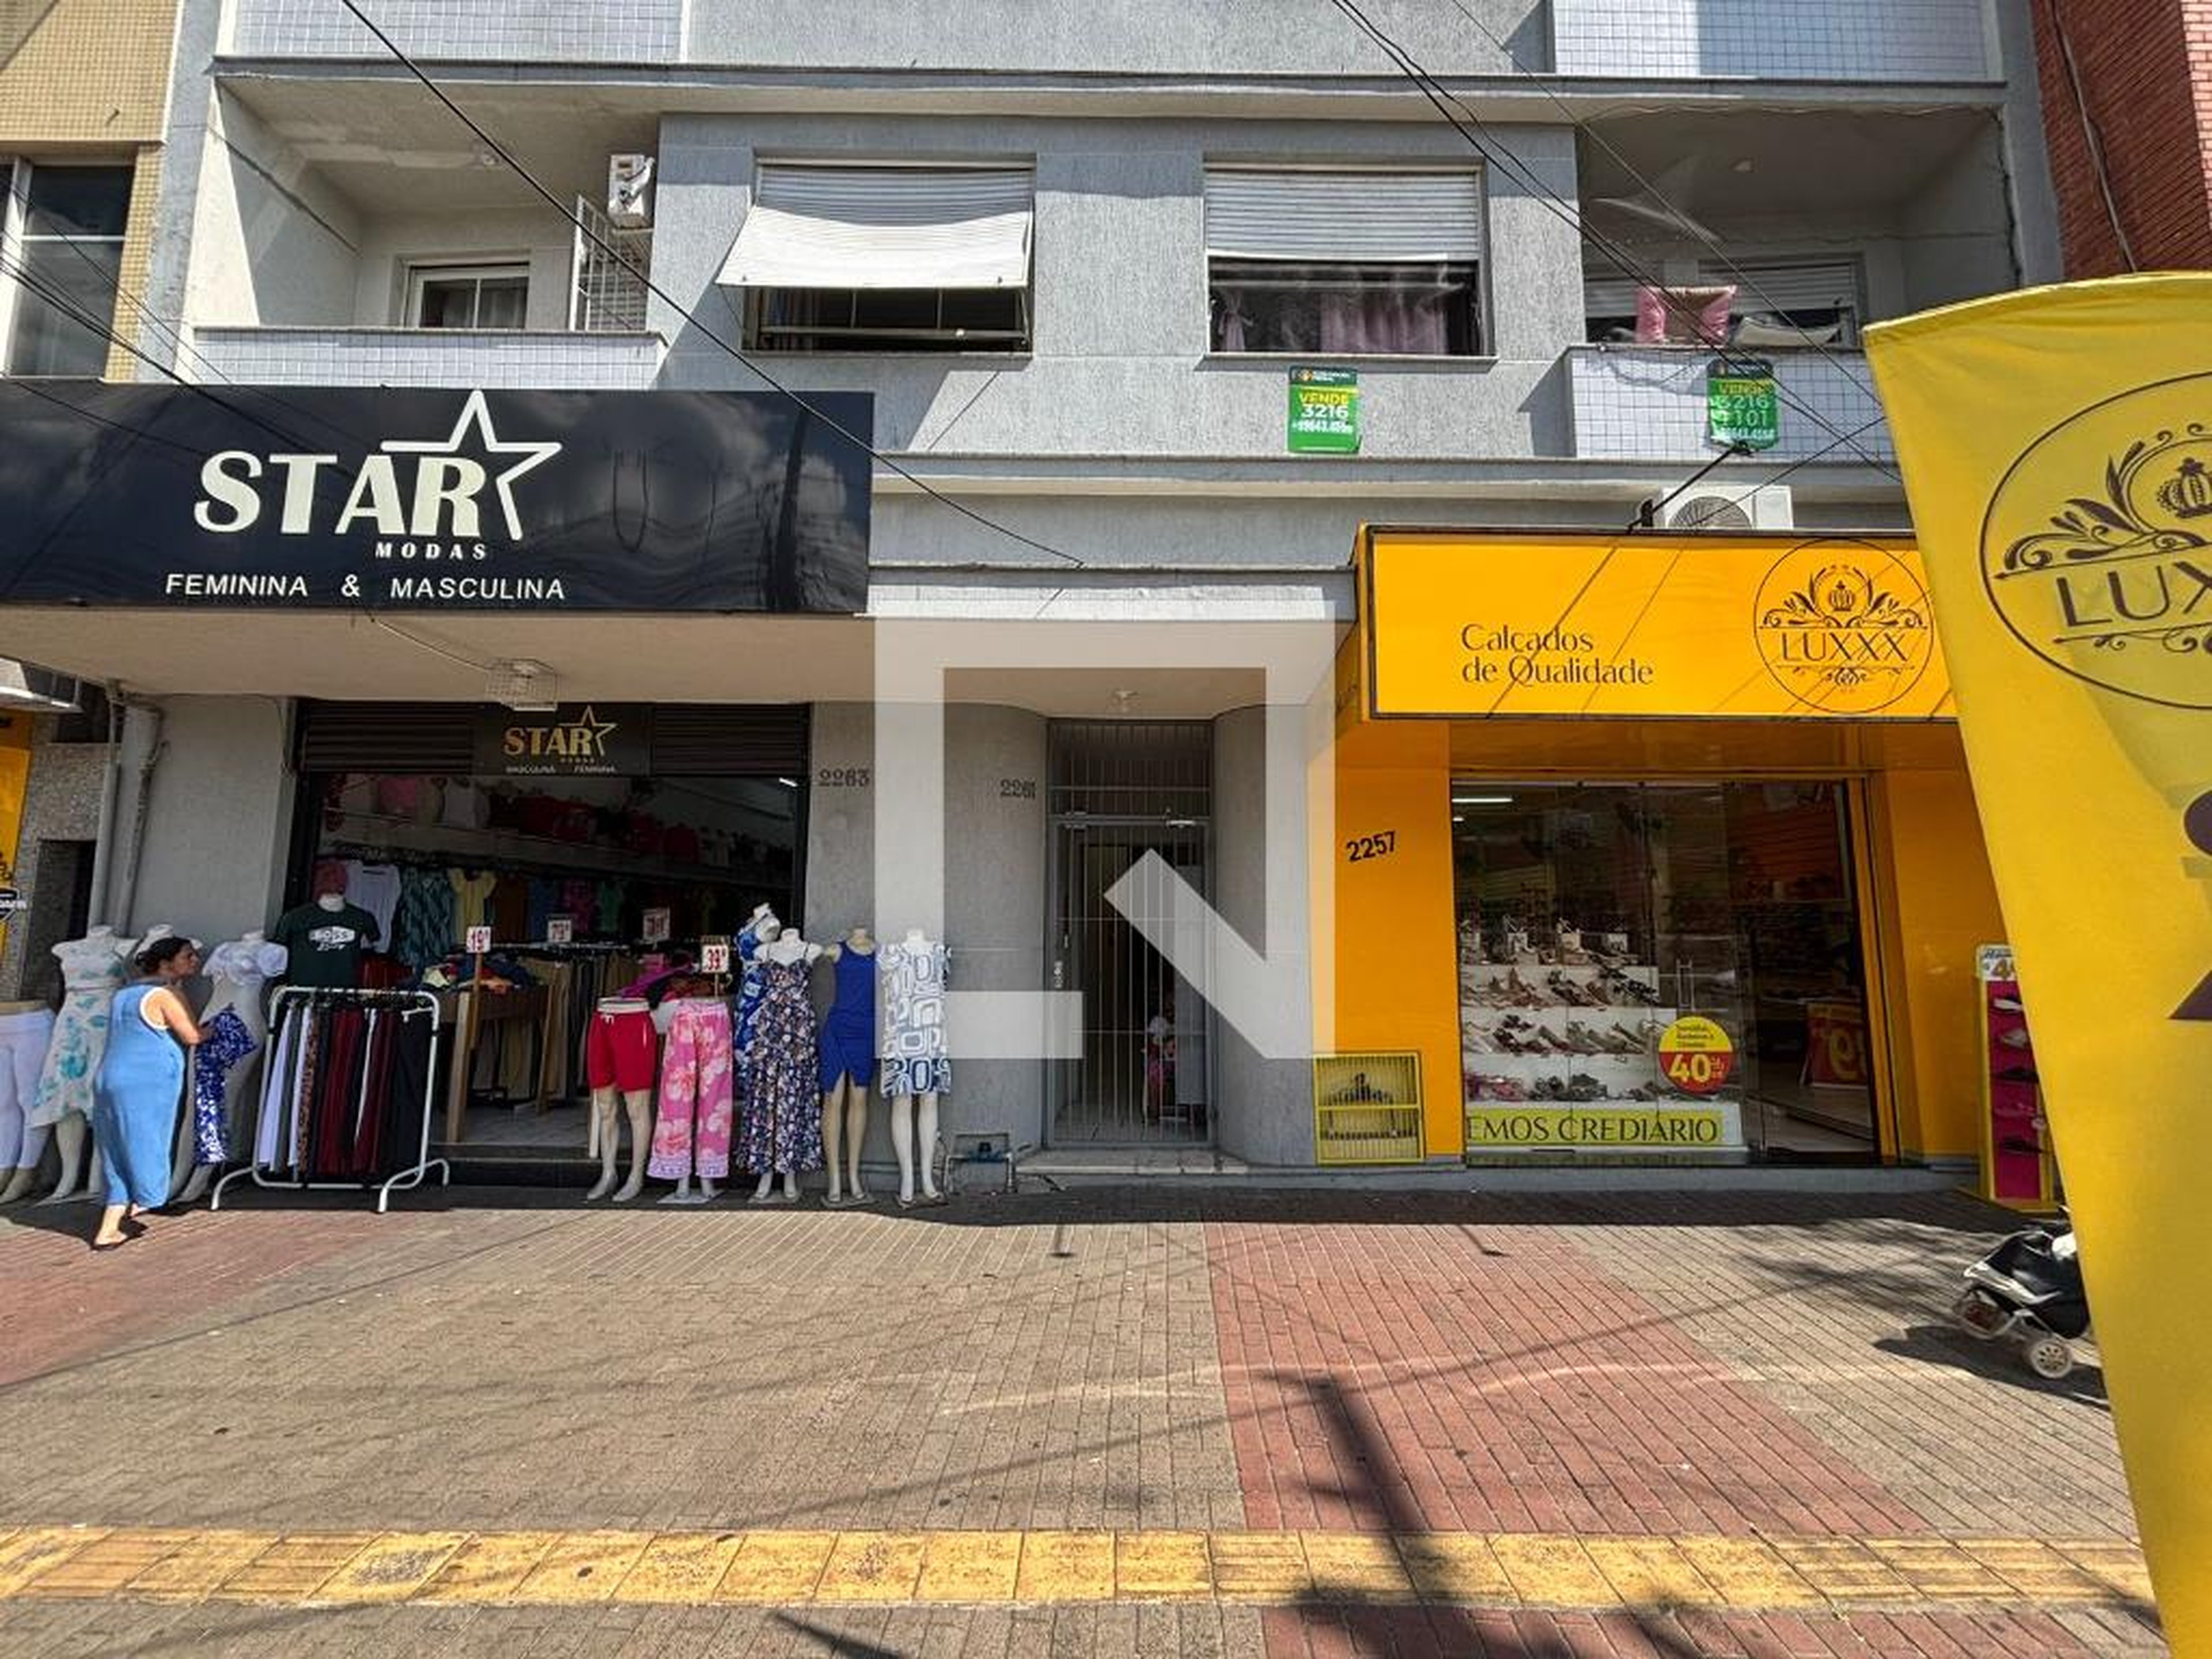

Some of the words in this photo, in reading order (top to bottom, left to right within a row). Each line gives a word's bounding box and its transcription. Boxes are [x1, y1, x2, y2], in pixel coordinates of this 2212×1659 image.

[1299, 393, 1349, 406] VENDE
[1301, 404, 1349, 419] 3216
[193, 450, 487, 538] STAR
[375, 542, 487, 560] MODAS
[165, 573, 309, 597] FEMININA
[341, 574, 361, 598] &
[389, 578, 566, 600] MASCULINA
[1461, 623, 1594, 653] Calçados
[1782, 632, 1907, 662] LUXXX
[1462, 656, 1498, 683] de
[1508, 654, 1653, 688] Qualidade
[503, 726, 593, 755] STAR
[819, 768, 870, 787] 2263
[1346, 830, 1396, 862] 2257
